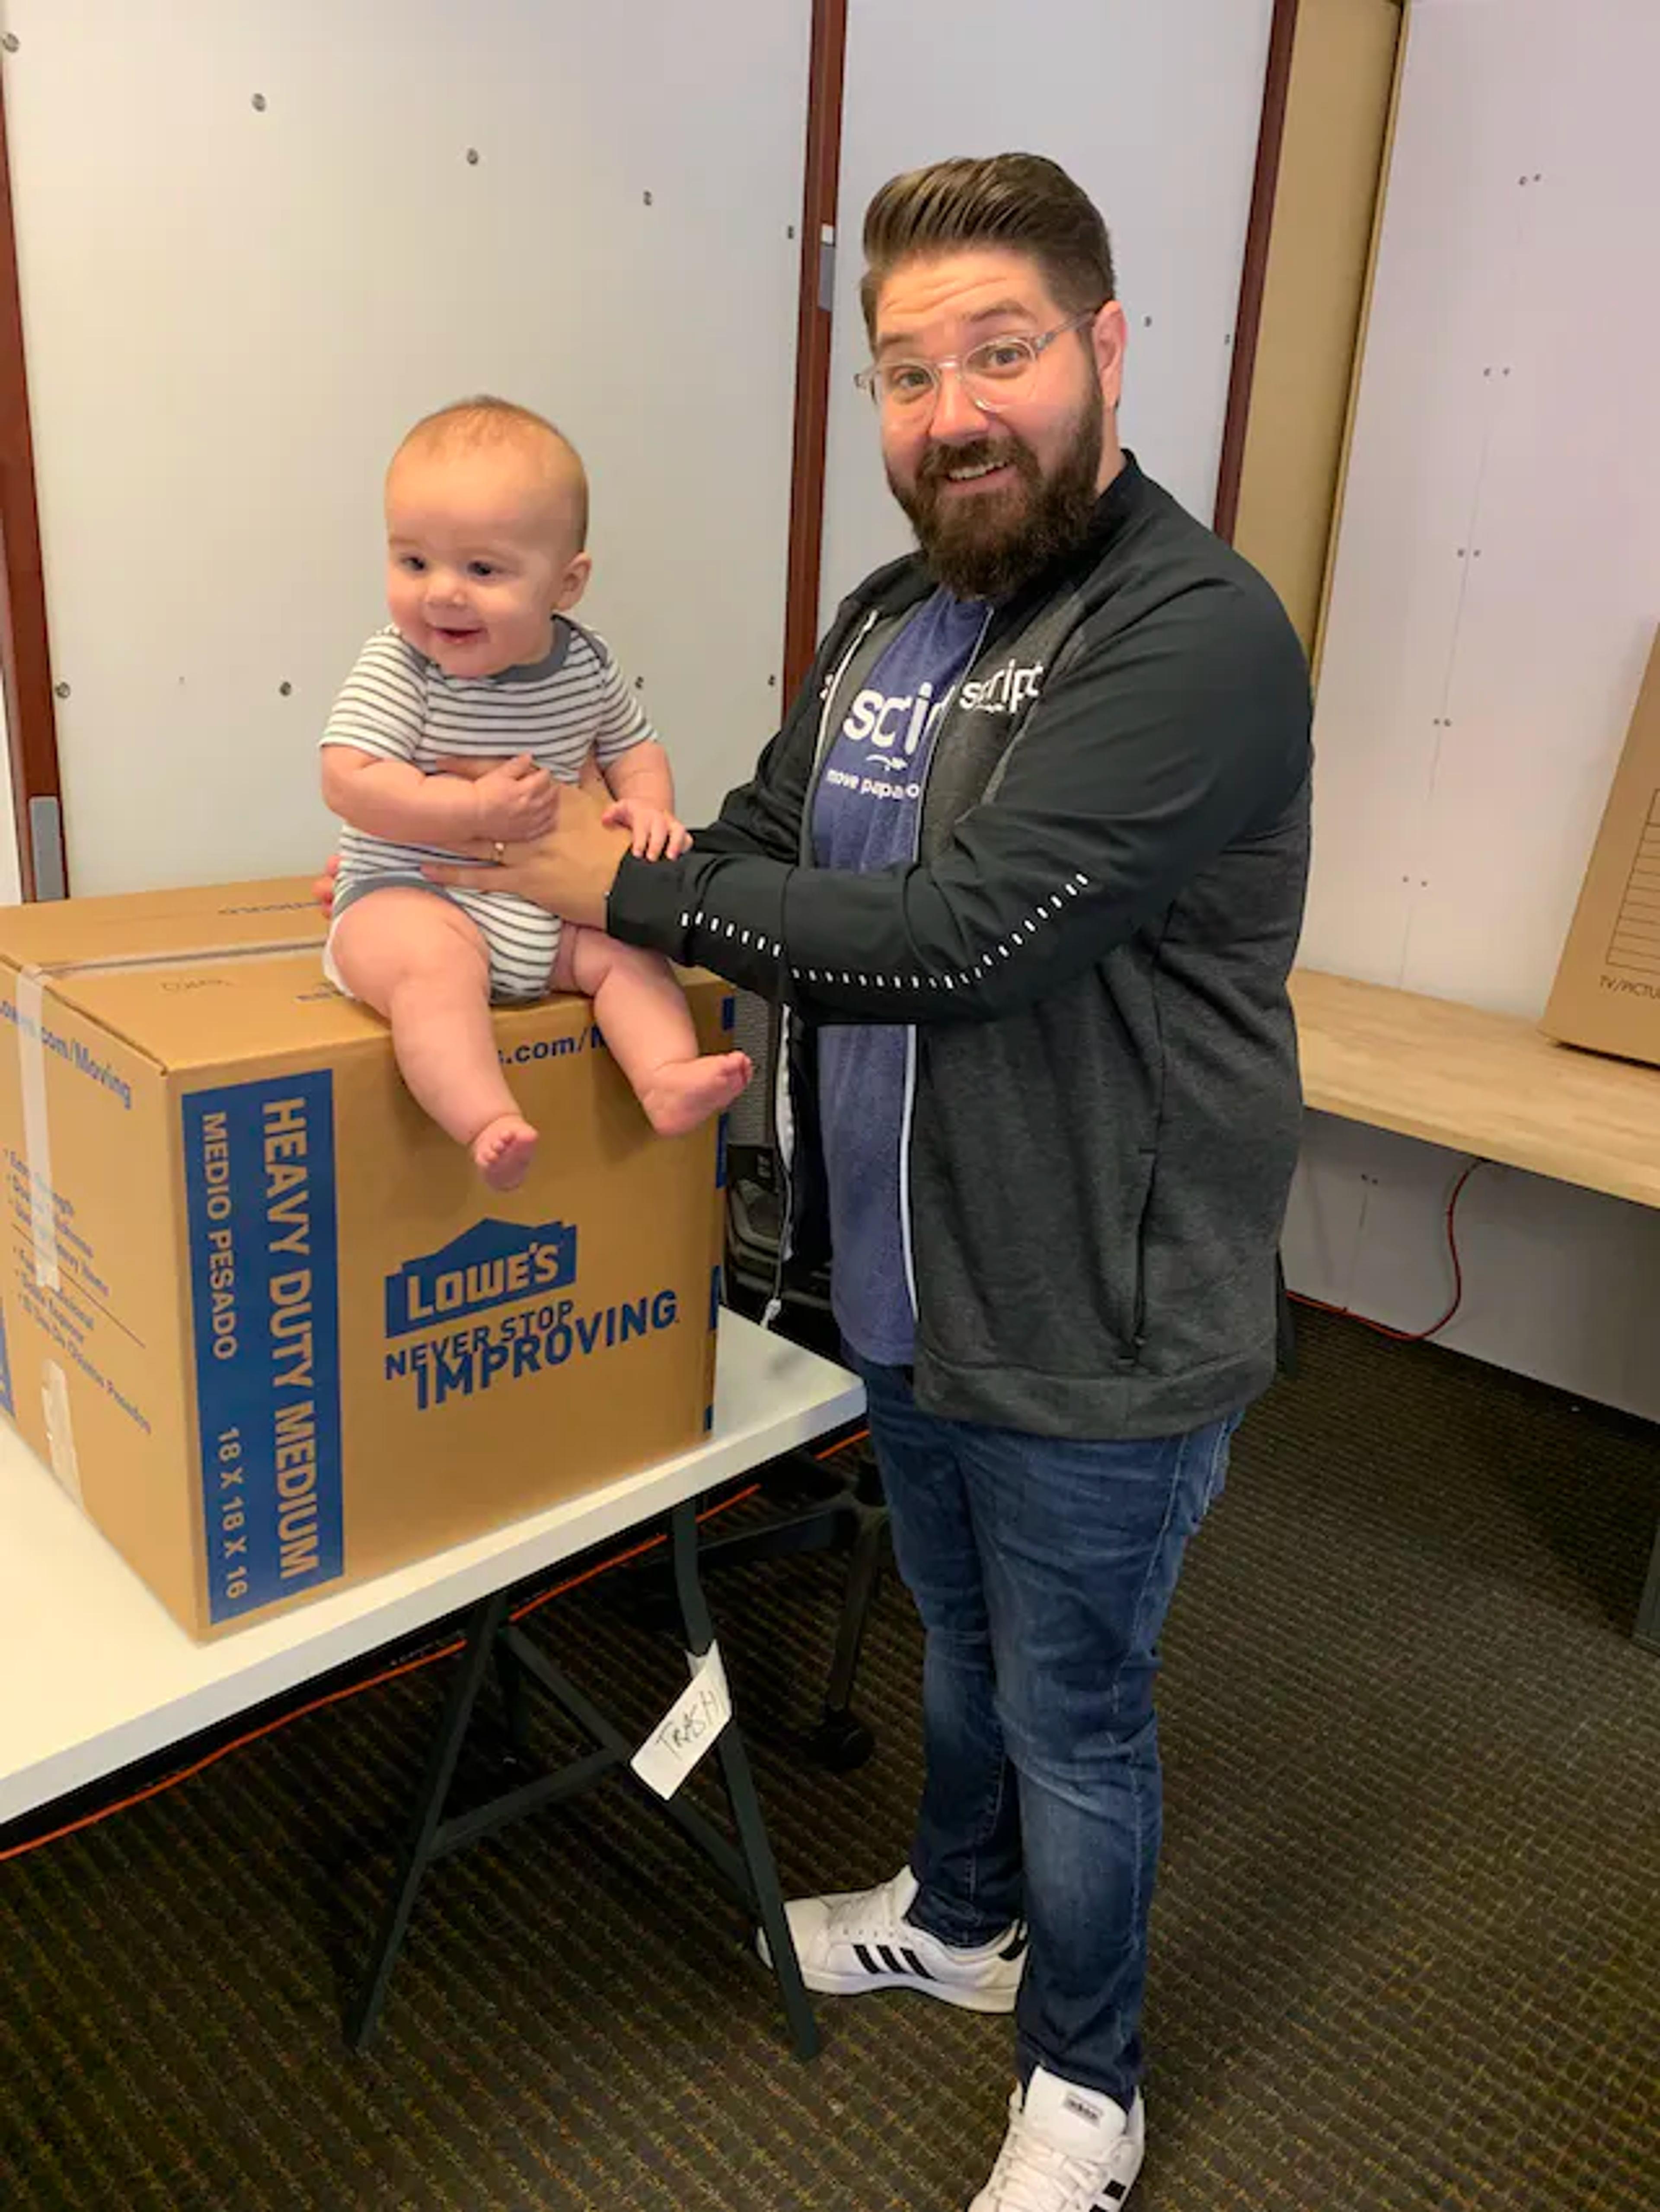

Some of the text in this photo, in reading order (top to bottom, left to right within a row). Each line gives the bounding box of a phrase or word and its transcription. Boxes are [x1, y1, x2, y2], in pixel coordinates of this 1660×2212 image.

[959, 659, 1044, 713] script
[202, 1111, 238, 1360] MEDIO PESADO
[407, 1241, 560, 1320] LOWE'S
[262, 1096, 319, 1580] HEAVY DUTY MEDIUM
[386, 1299, 574, 1380] NEVER STOP
[417, 1289, 678, 1411] IMPROVING
[217, 1427, 241, 1463] 18
[222, 1496, 246, 1532] 18
[226, 1565, 249, 1599] 16
